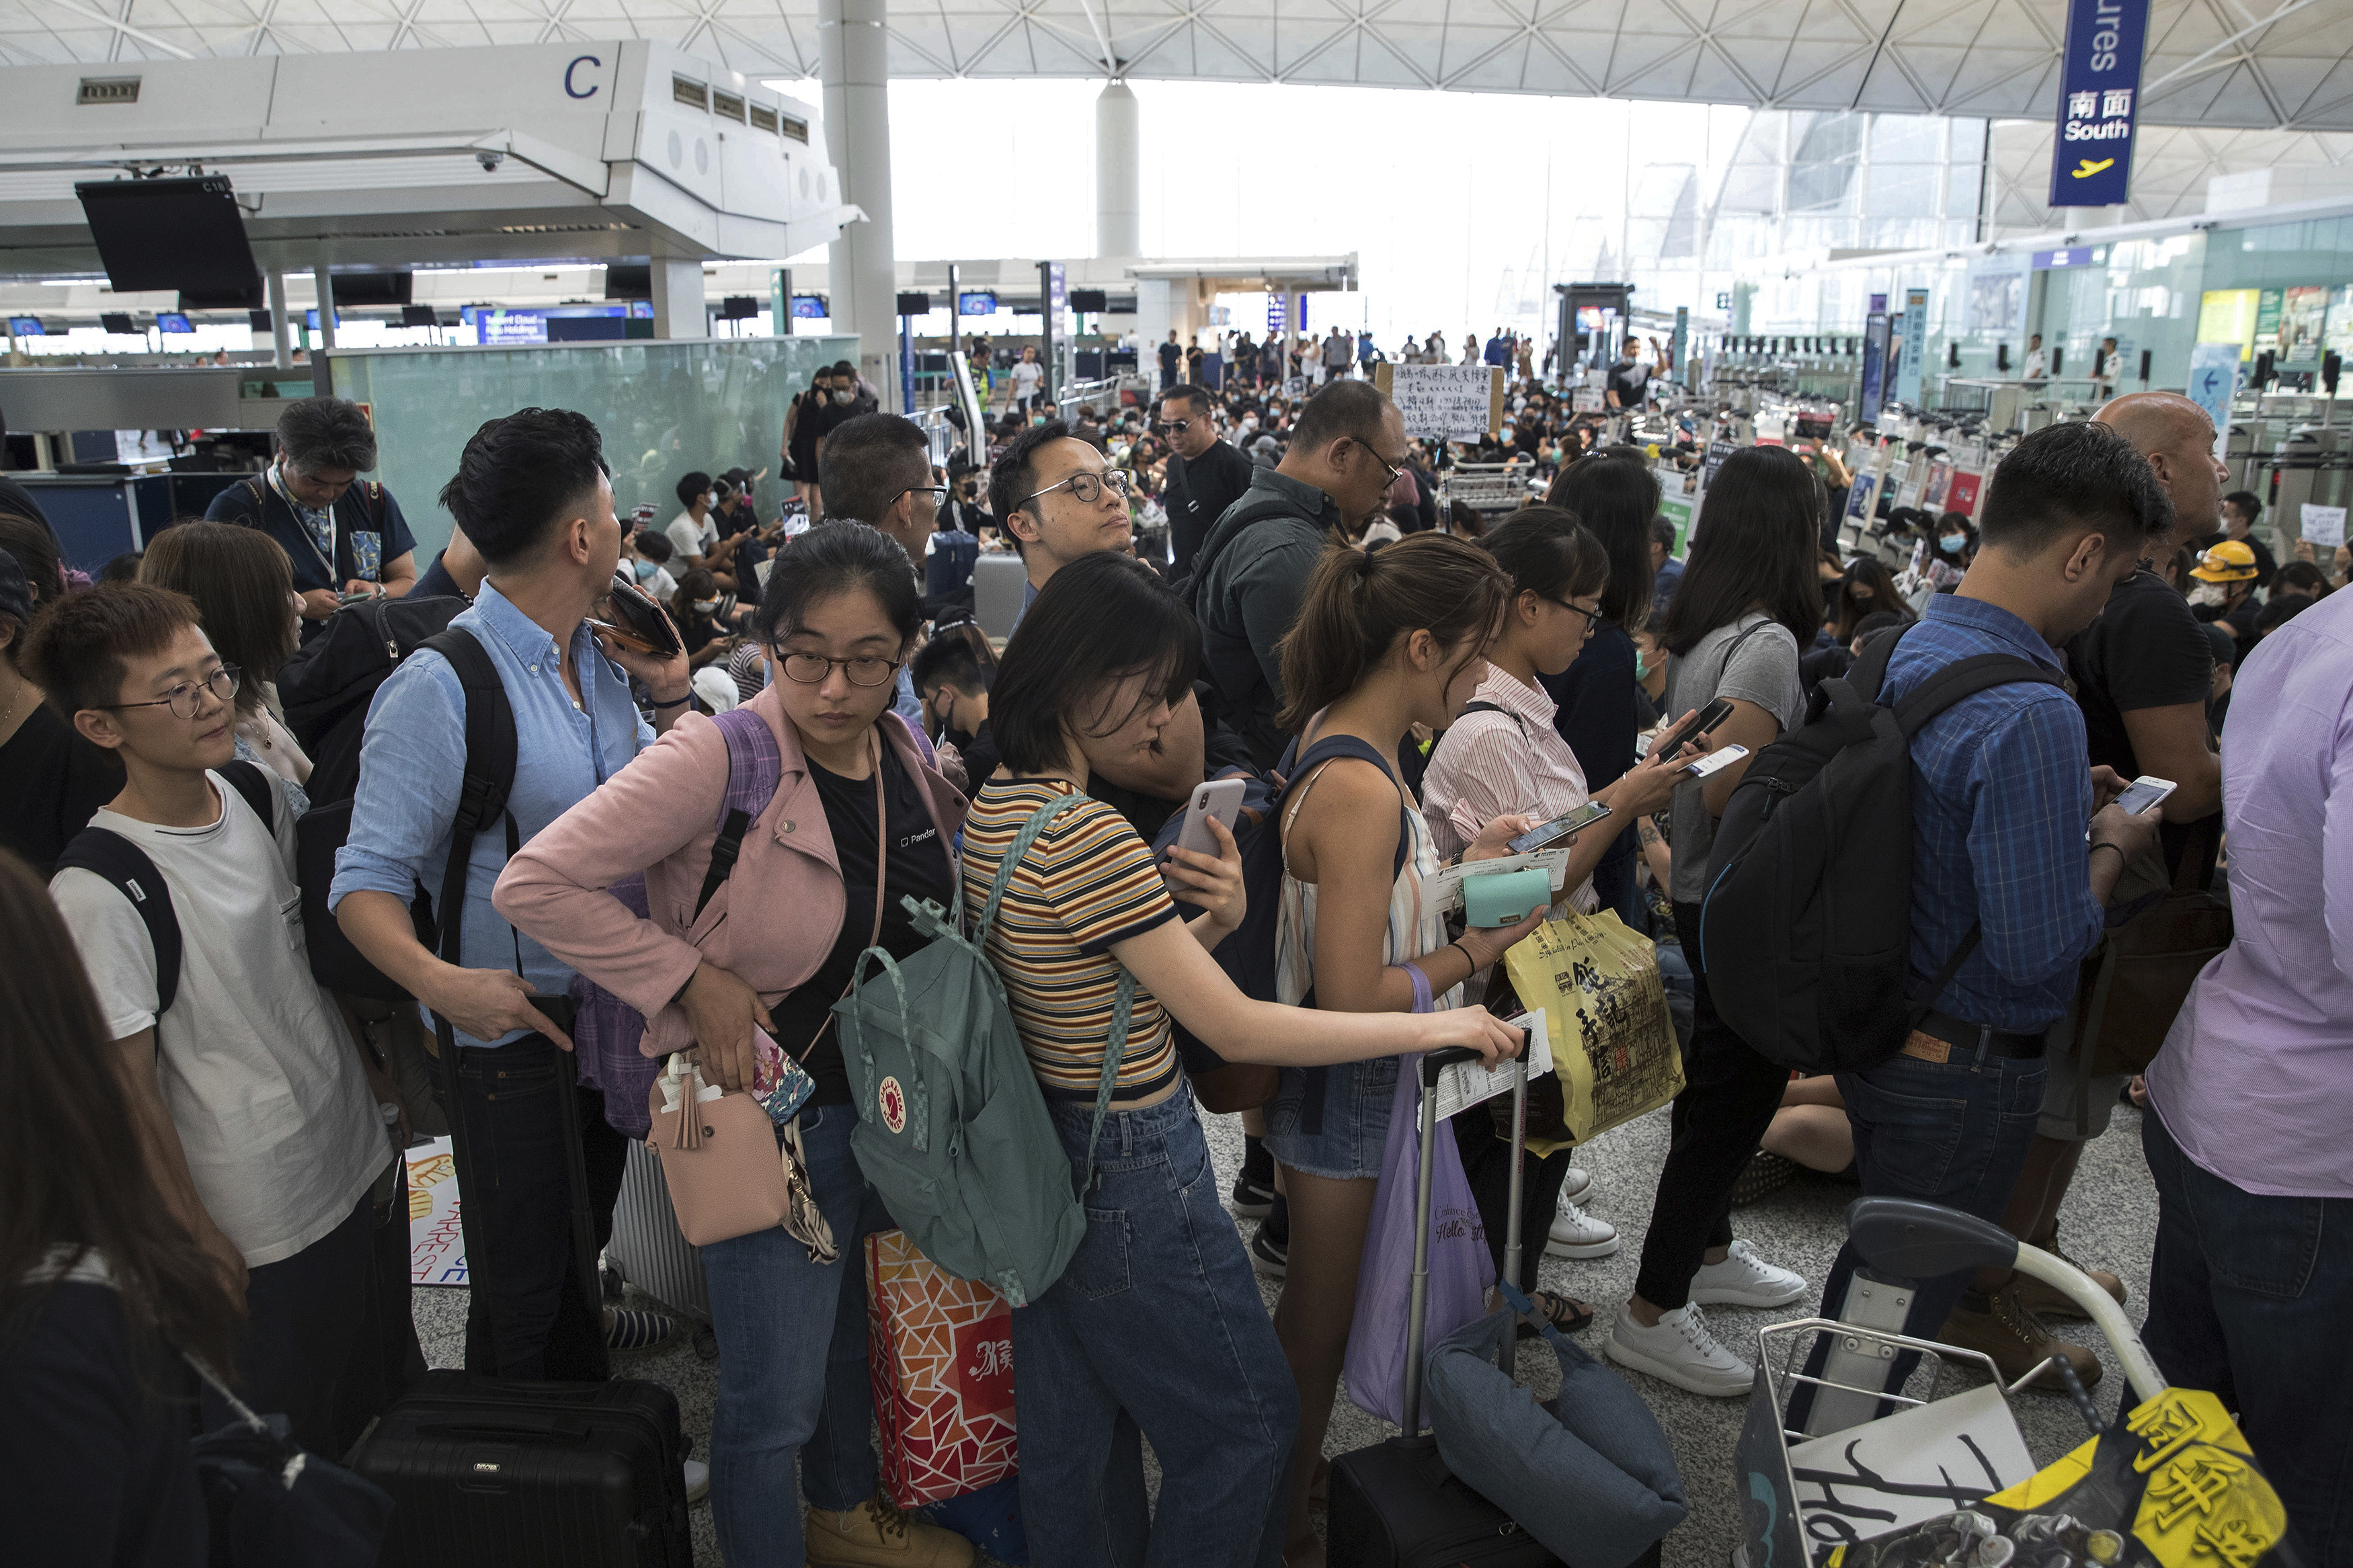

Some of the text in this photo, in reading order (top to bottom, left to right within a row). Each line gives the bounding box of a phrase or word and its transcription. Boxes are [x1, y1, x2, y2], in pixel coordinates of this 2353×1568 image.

[564, 55, 601, 99] C
[2068, 88, 2134, 120] 南面
[2064, 118, 2130, 141] South
[910, 828, 936, 844] Pandar
[129, 882, 143, 899] CONVERSE
[1436, 1220, 1466, 1244] Hello
[476, 1463, 498, 1471] RIMOWA
